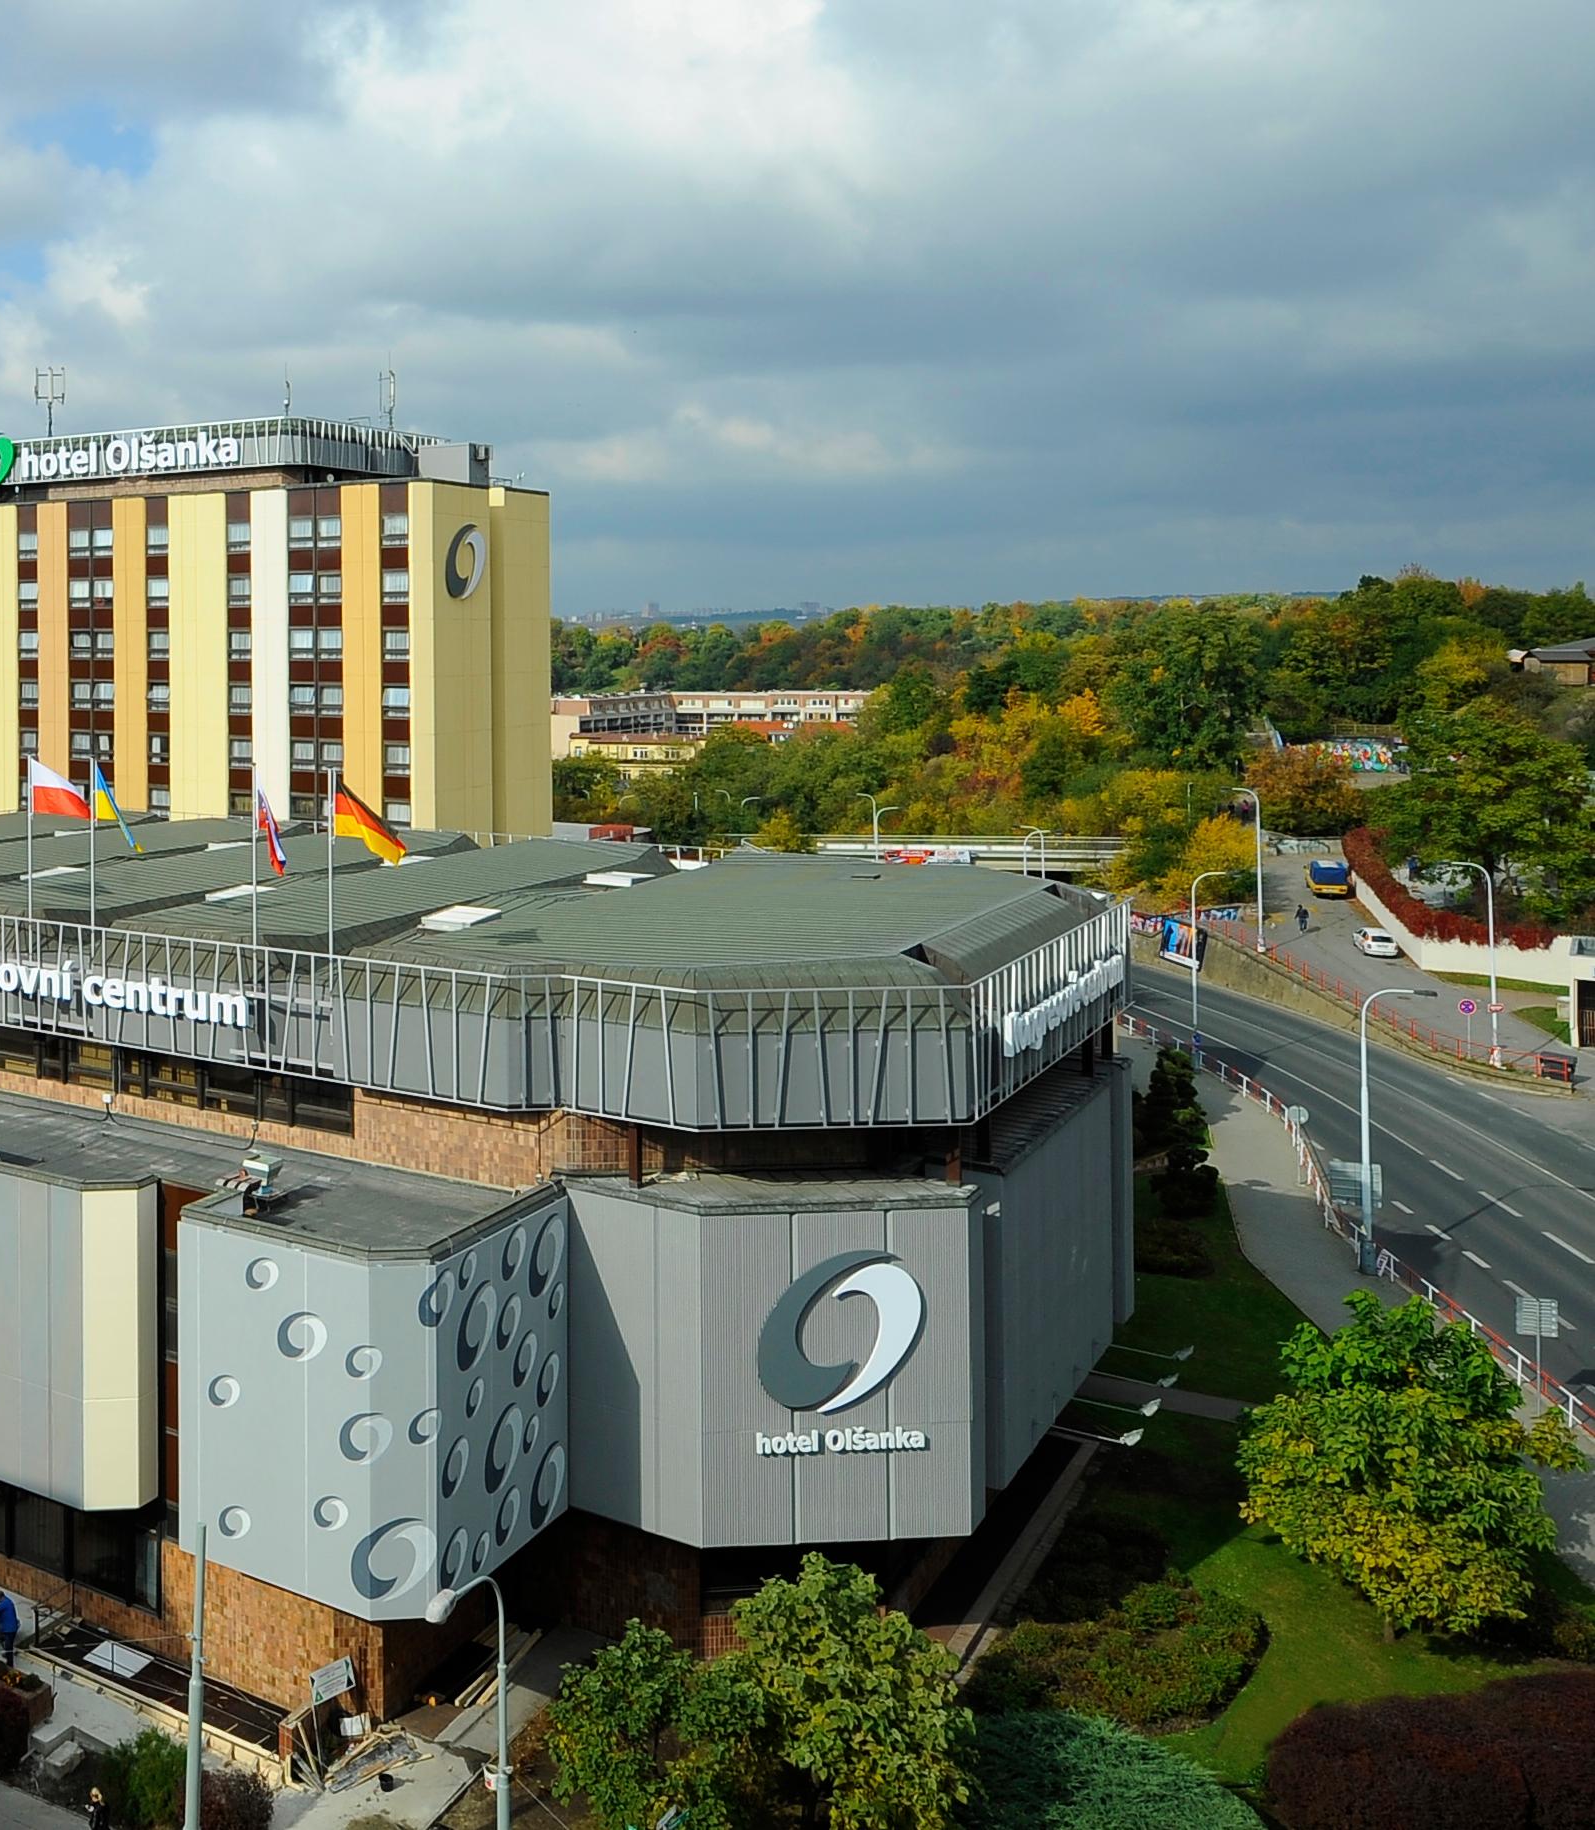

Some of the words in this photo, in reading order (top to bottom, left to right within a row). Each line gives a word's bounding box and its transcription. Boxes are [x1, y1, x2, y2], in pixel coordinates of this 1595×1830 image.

[21, 441, 97, 478] hotel
[105, 431, 239, 472] Olšanka
[82, 975, 249, 1028] centrum
[756, 1429, 819, 1455] hotel
[825, 1426, 925, 1452] Olšanka
